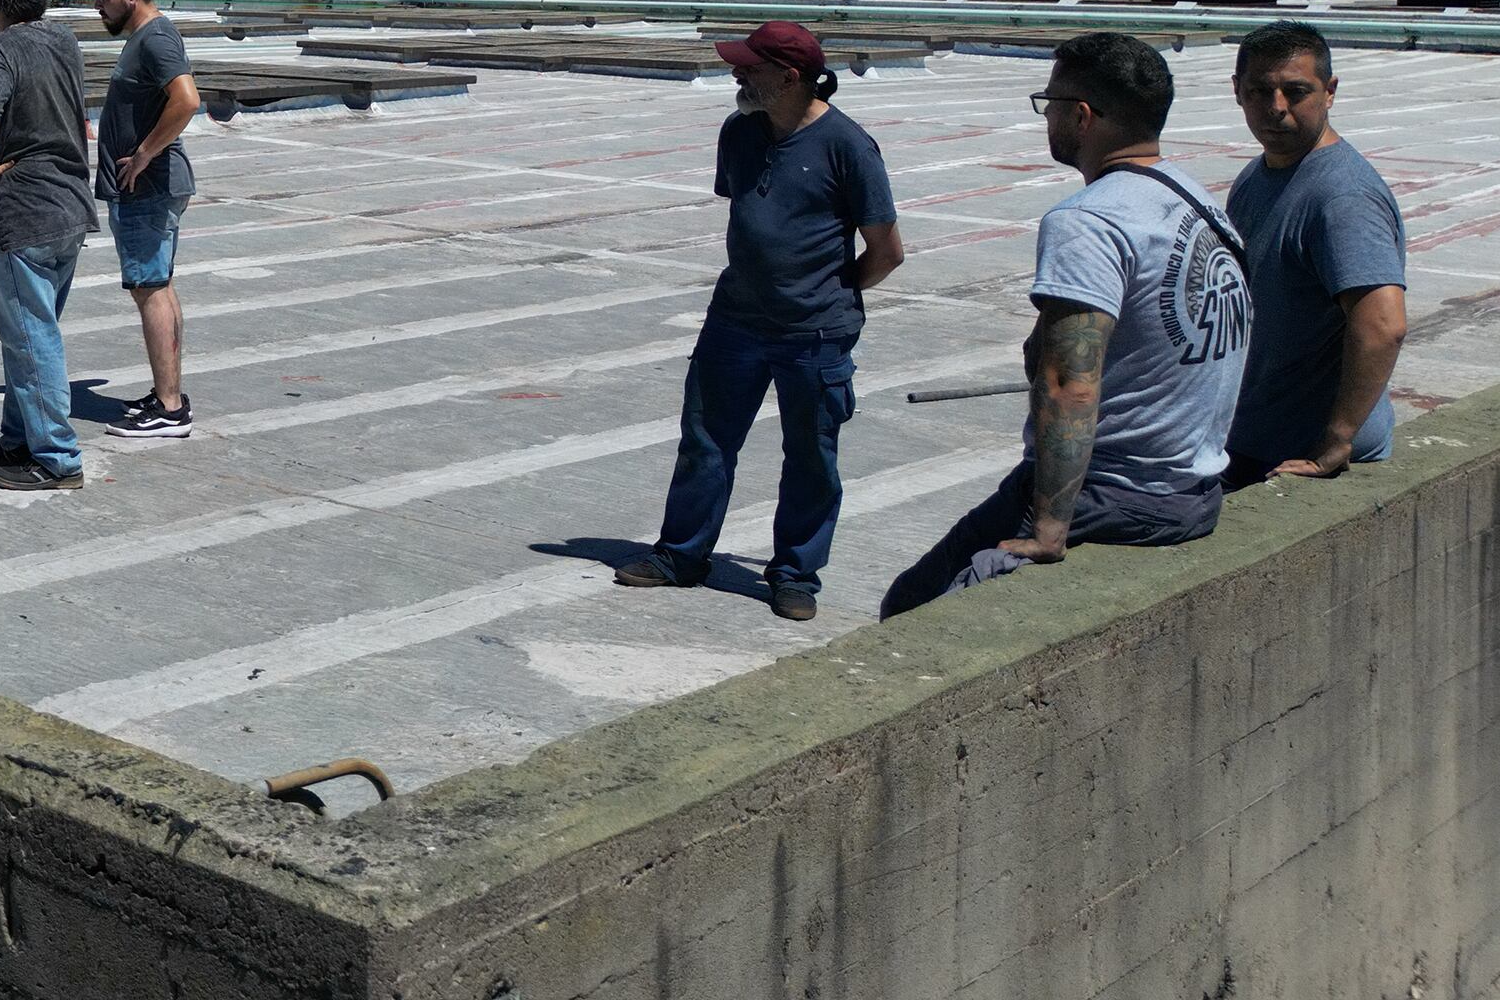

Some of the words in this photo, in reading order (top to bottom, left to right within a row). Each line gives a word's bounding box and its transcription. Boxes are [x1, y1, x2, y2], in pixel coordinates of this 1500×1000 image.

[1173, 238, 1188, 254] DE
[1161, 253, 1183, 288] UNICO
[1159, 290, 1188, 348] SINDICATO
